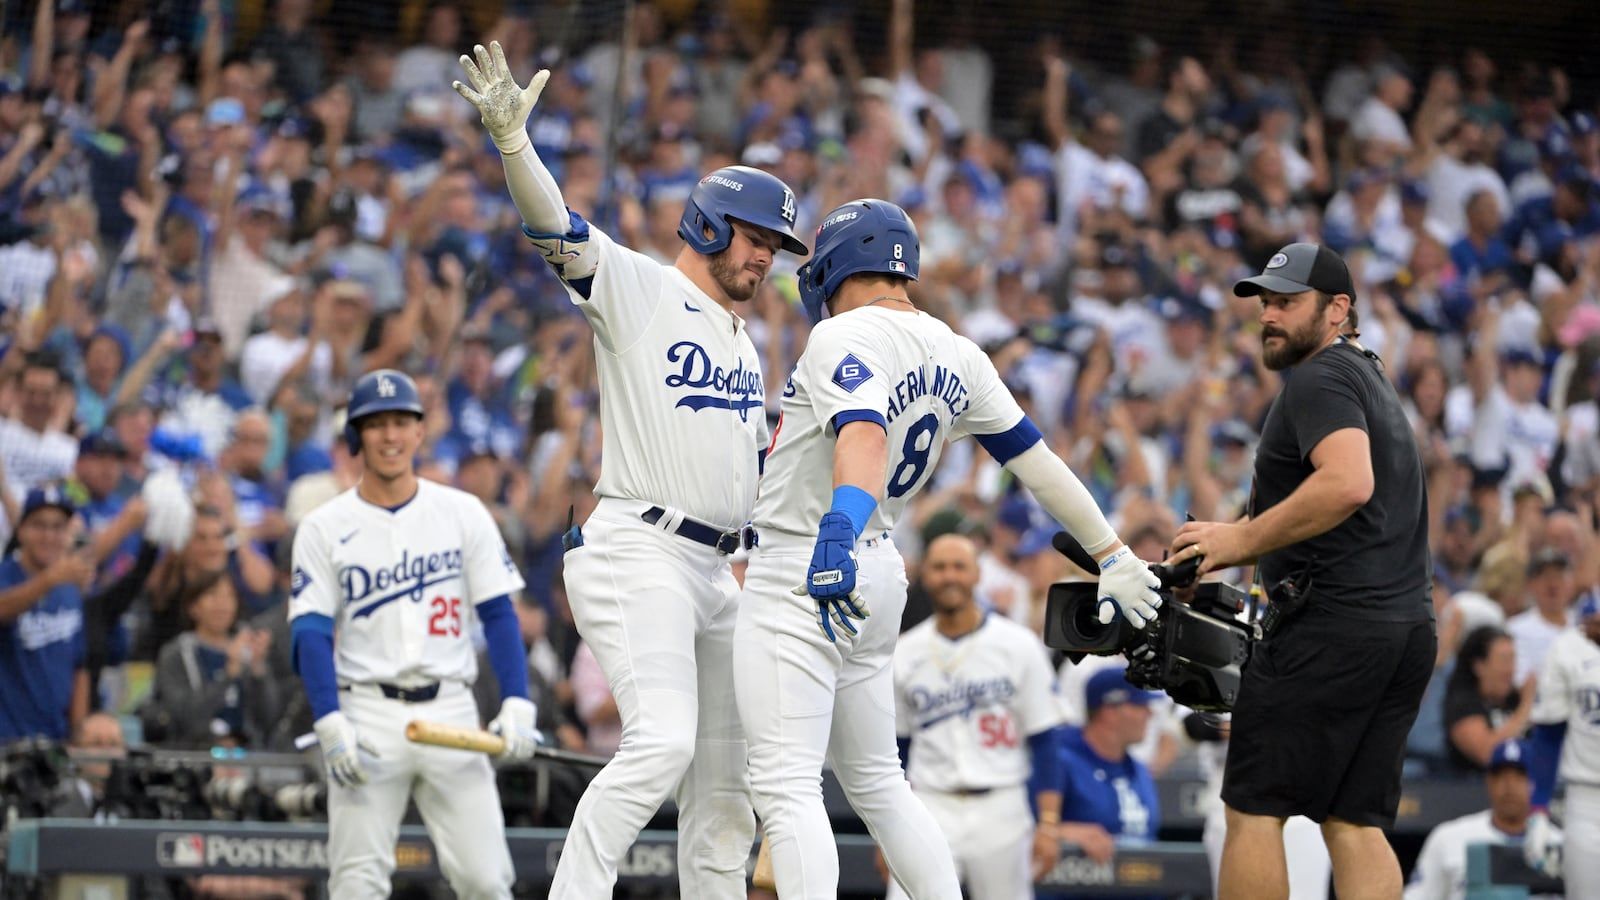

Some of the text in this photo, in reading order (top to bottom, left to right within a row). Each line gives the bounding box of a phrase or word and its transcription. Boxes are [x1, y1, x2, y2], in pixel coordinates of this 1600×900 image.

[708, 175, 743, 192] STRAUSS
[781, 189, 795, 222] LA
[822, 211, 859, 230] STRAUSS
[893, 243, 903, 259] 8
[376, 374, 397, 398] LA
[665, 341, 764, 423] Dodgers
[841, 363, 860, 378] G
[886, 363, 970, 426] HERNNDE
[887, 413, 939, 498] 8
[338, 550, 463, 604] Dodgers
[428, 596, 461, 638] 25
[206, 834, 329, 868] POSTSEA
[614, 844, 675, 877] LDS
